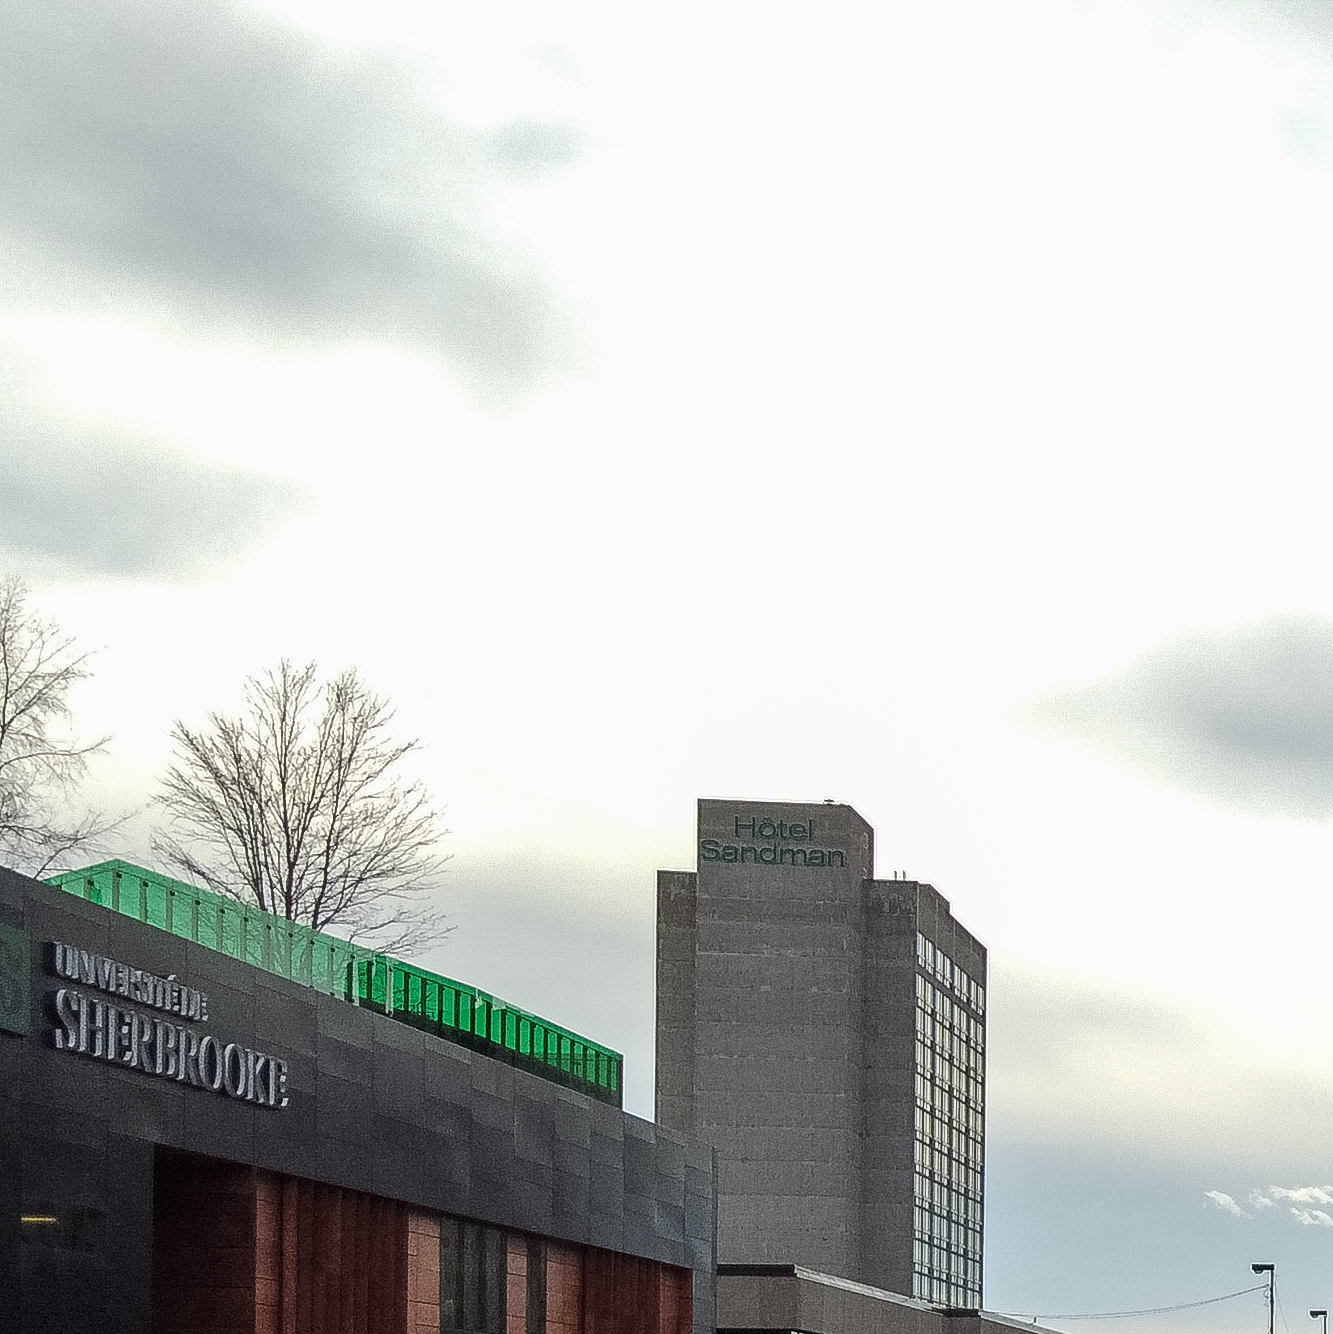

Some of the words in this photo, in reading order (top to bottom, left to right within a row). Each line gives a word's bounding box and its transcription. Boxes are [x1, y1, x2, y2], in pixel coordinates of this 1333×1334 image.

[700, 838, 846, 867] Sandman
[734, 815, 815, 842] Hôtel
[55, 941, 180, 1012] UNIVERSITÉ
[55, 988, 289, 1107] SHERBROOKE
